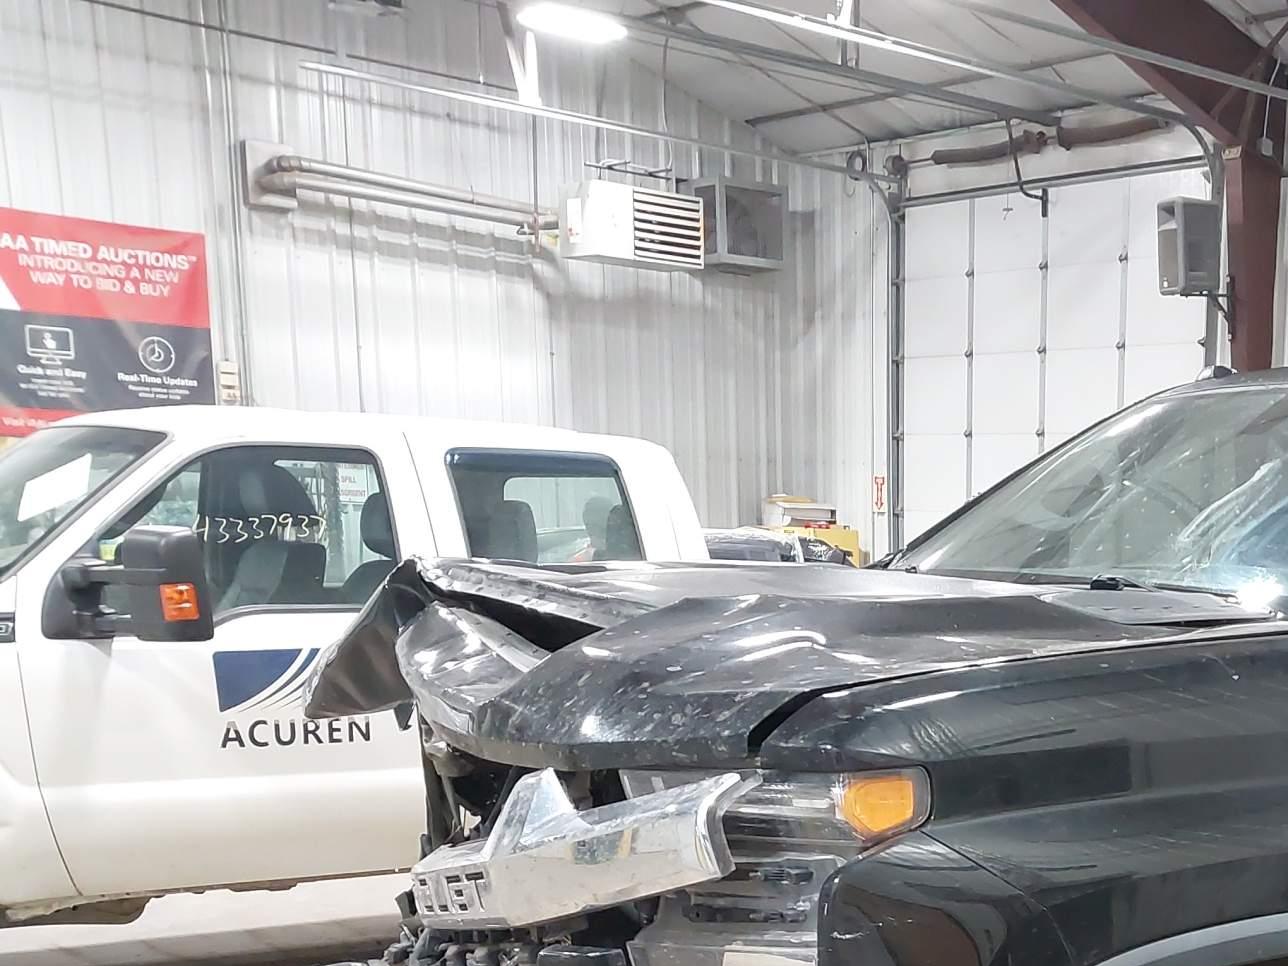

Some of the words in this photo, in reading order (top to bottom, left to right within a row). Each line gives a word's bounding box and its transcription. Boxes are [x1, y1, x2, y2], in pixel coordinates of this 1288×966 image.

[30, 236, 93, 258] TIMED
[18, 253, 127, 278] INTRODUCING
[129, 265, 142, 280] A
[144, 268, 180, 284] NEW
[29, 270, 67, 286] WAY
[69, 273, 93, 289] TO
[95, 277, 121, 292] BID
[123, 280, 137, 294] &
[139, 282, 171, 297] BUY
[117, 372, 162, 384] Real-Time
[162, 375, 198, 387] Updates
[190, 513, 327, 544] 43337937
[219, 716, 372, 749] ACUREN
